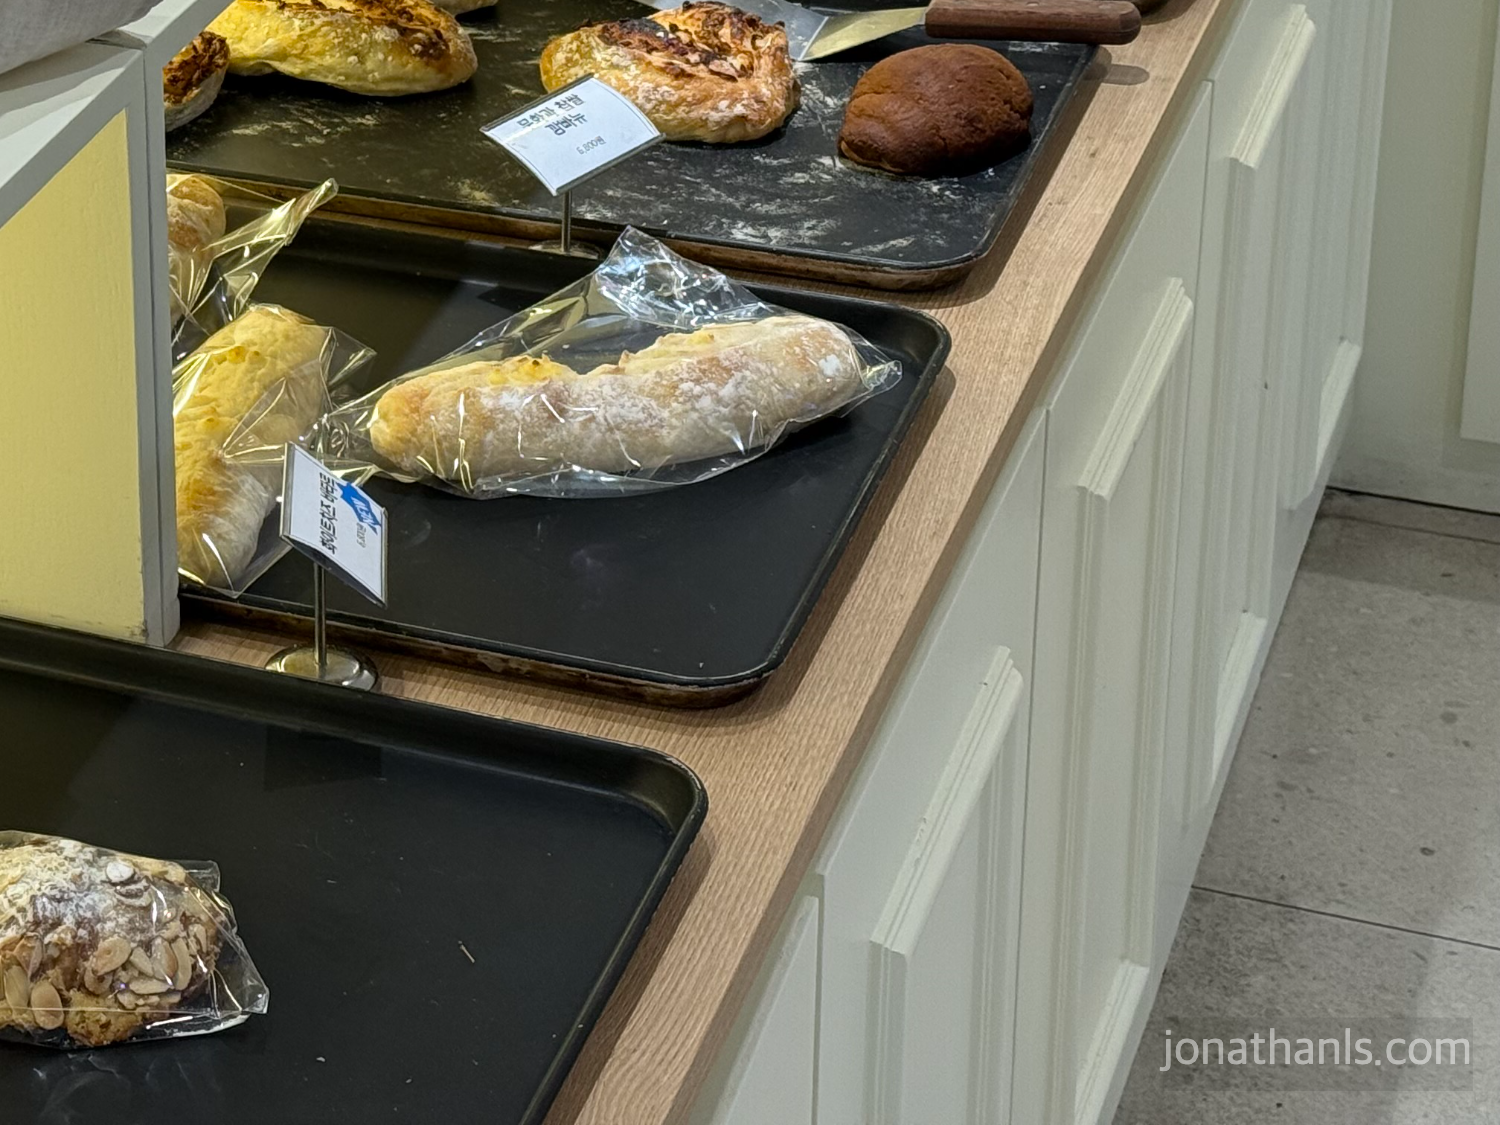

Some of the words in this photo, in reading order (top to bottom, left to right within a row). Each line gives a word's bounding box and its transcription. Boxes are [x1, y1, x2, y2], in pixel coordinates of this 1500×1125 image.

[516, 106, 558, 129] 무화과
[553, 93, 586, 112] 찹쌀
[318, 499, 338, 555] 화이트치즈
[350, 496, 374, 524] NEW
